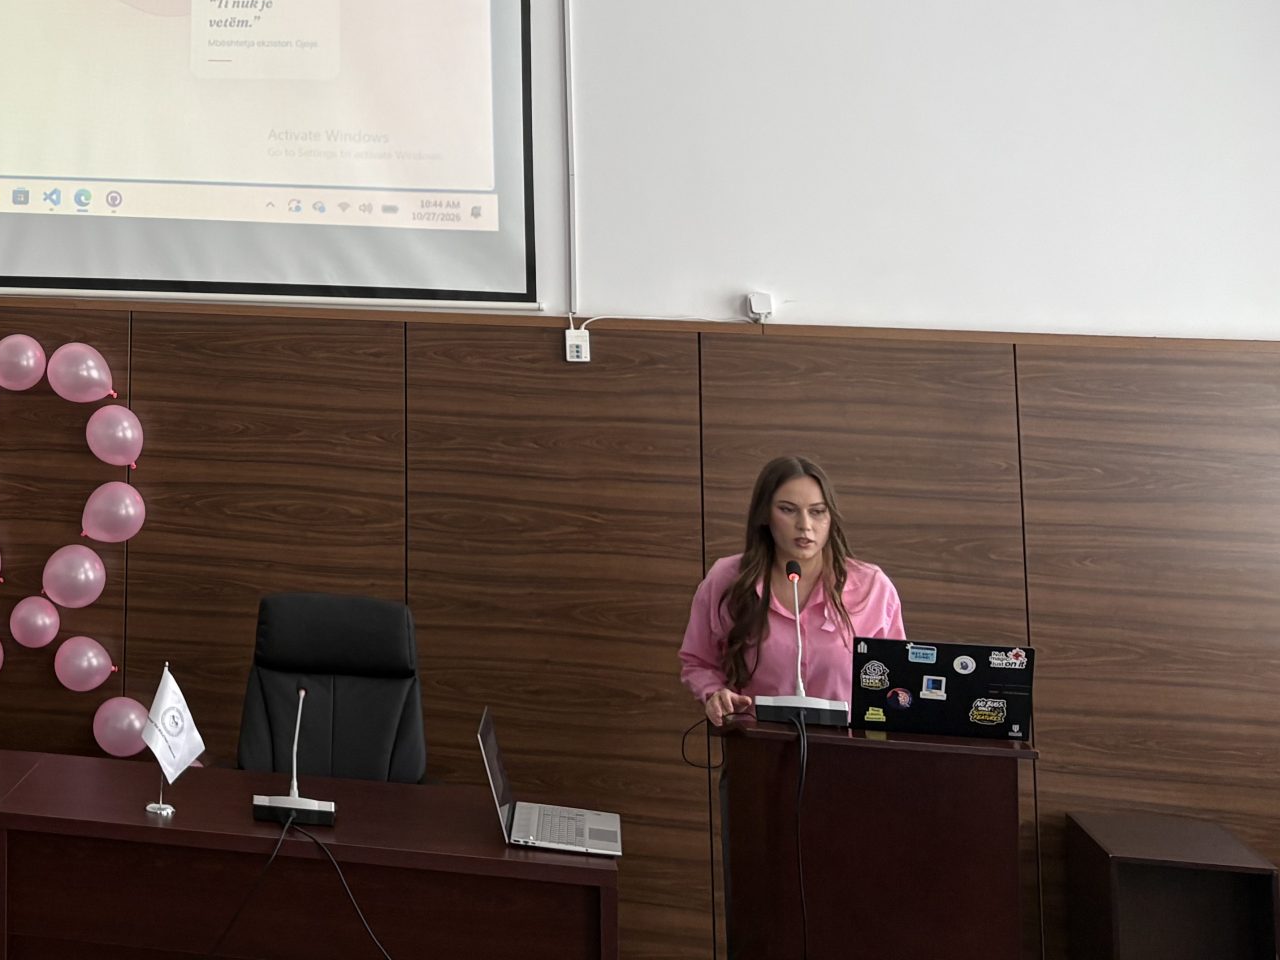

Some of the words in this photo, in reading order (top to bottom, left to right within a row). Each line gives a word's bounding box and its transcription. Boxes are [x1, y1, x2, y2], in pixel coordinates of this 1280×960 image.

[268, 128, 321, 141] Activate
[324, 129, 390, 144] Windows
[267, 147, 281, 157] Go
[445, 200, 461, 209] AM
